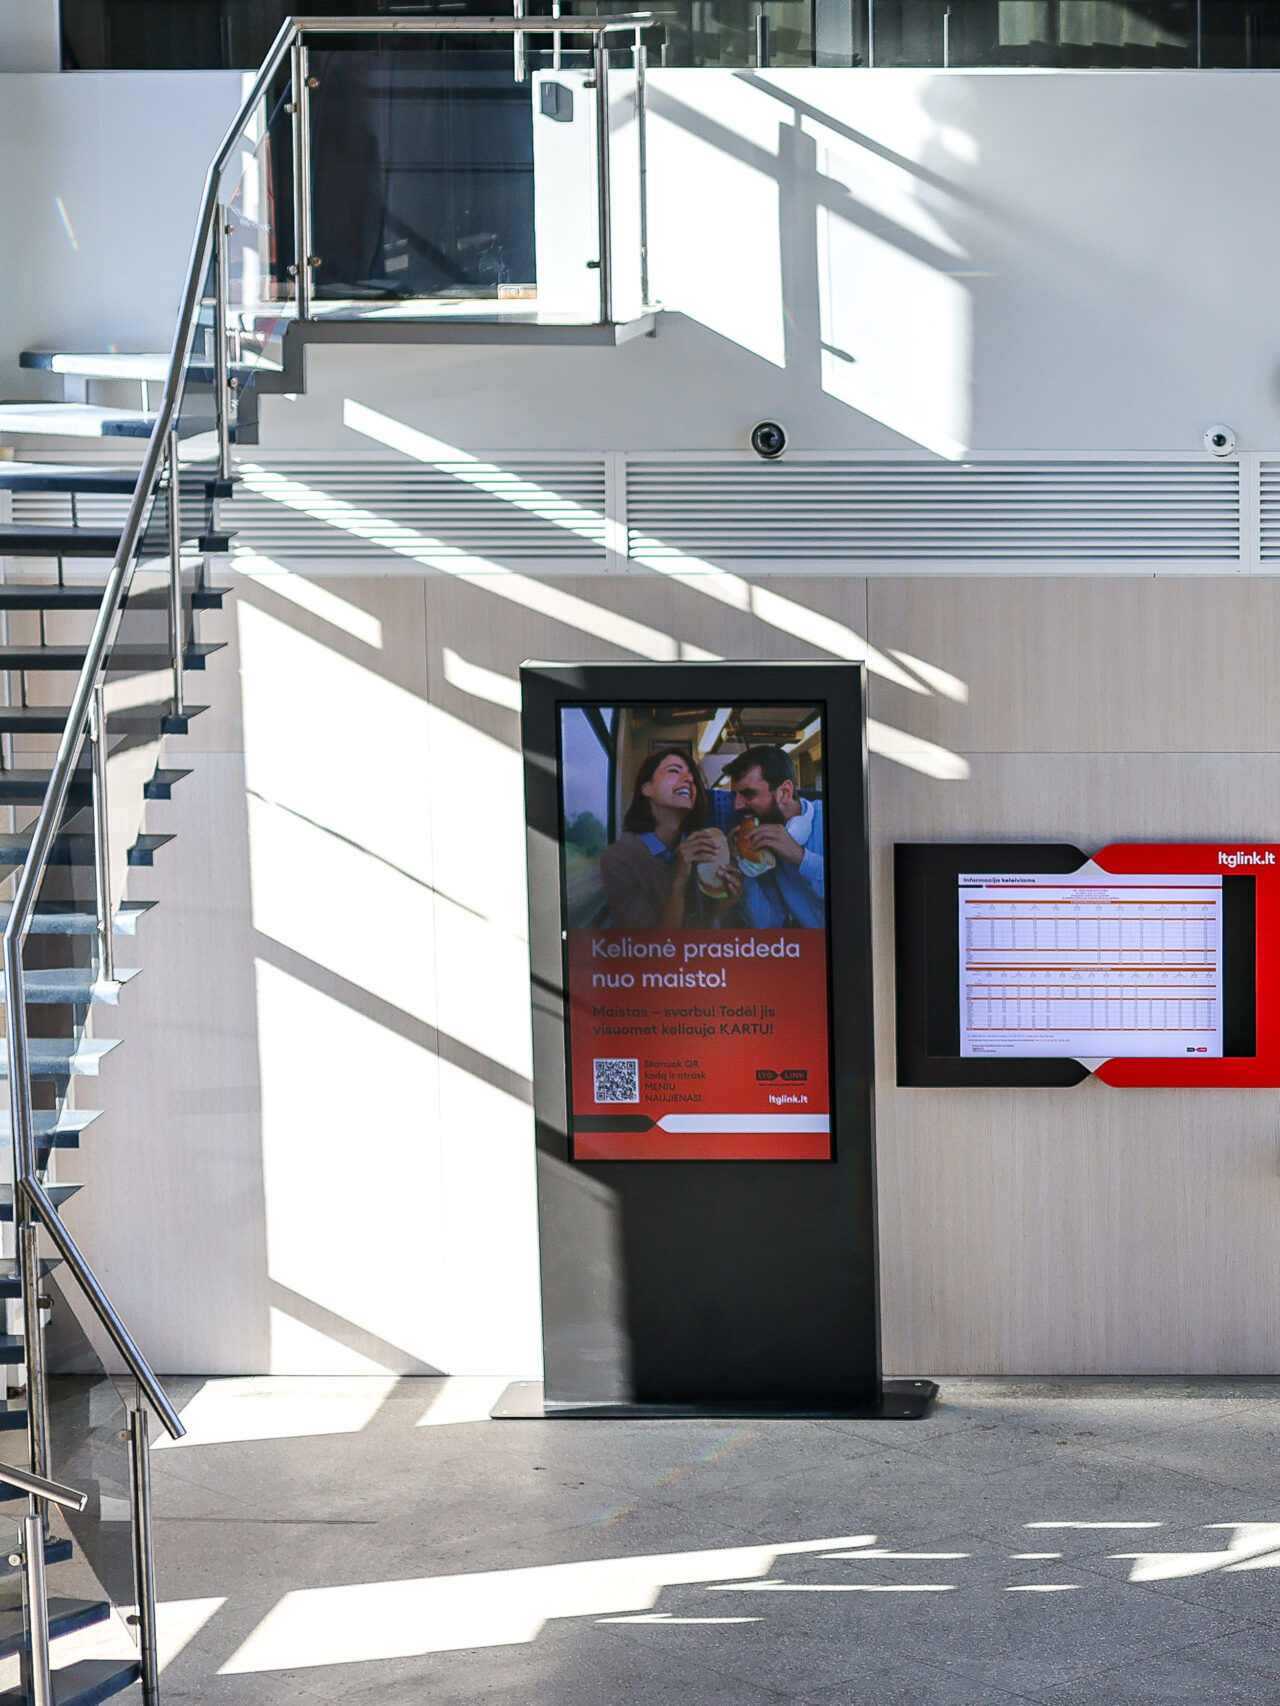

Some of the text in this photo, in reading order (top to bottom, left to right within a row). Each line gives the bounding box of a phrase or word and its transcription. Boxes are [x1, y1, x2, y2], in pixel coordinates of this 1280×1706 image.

[1219, 851, 1275, 868] ltglink.lt
[592, 938, 800, 962] Kelionė prasideda
[592, 968, 727, 988] nuo maisto!
[593, 1006, 648, 1017] Maistas
[664, 1006, 715, 1017] svarbu!
[720, 1005, 756, 1017] Todėl
[760, 1006, 775, 1020] jis
[593, 1024, 773, 1038] visuomet keliauja KARTU!
[769, 1094, 808, 1105] ltglink.lt
